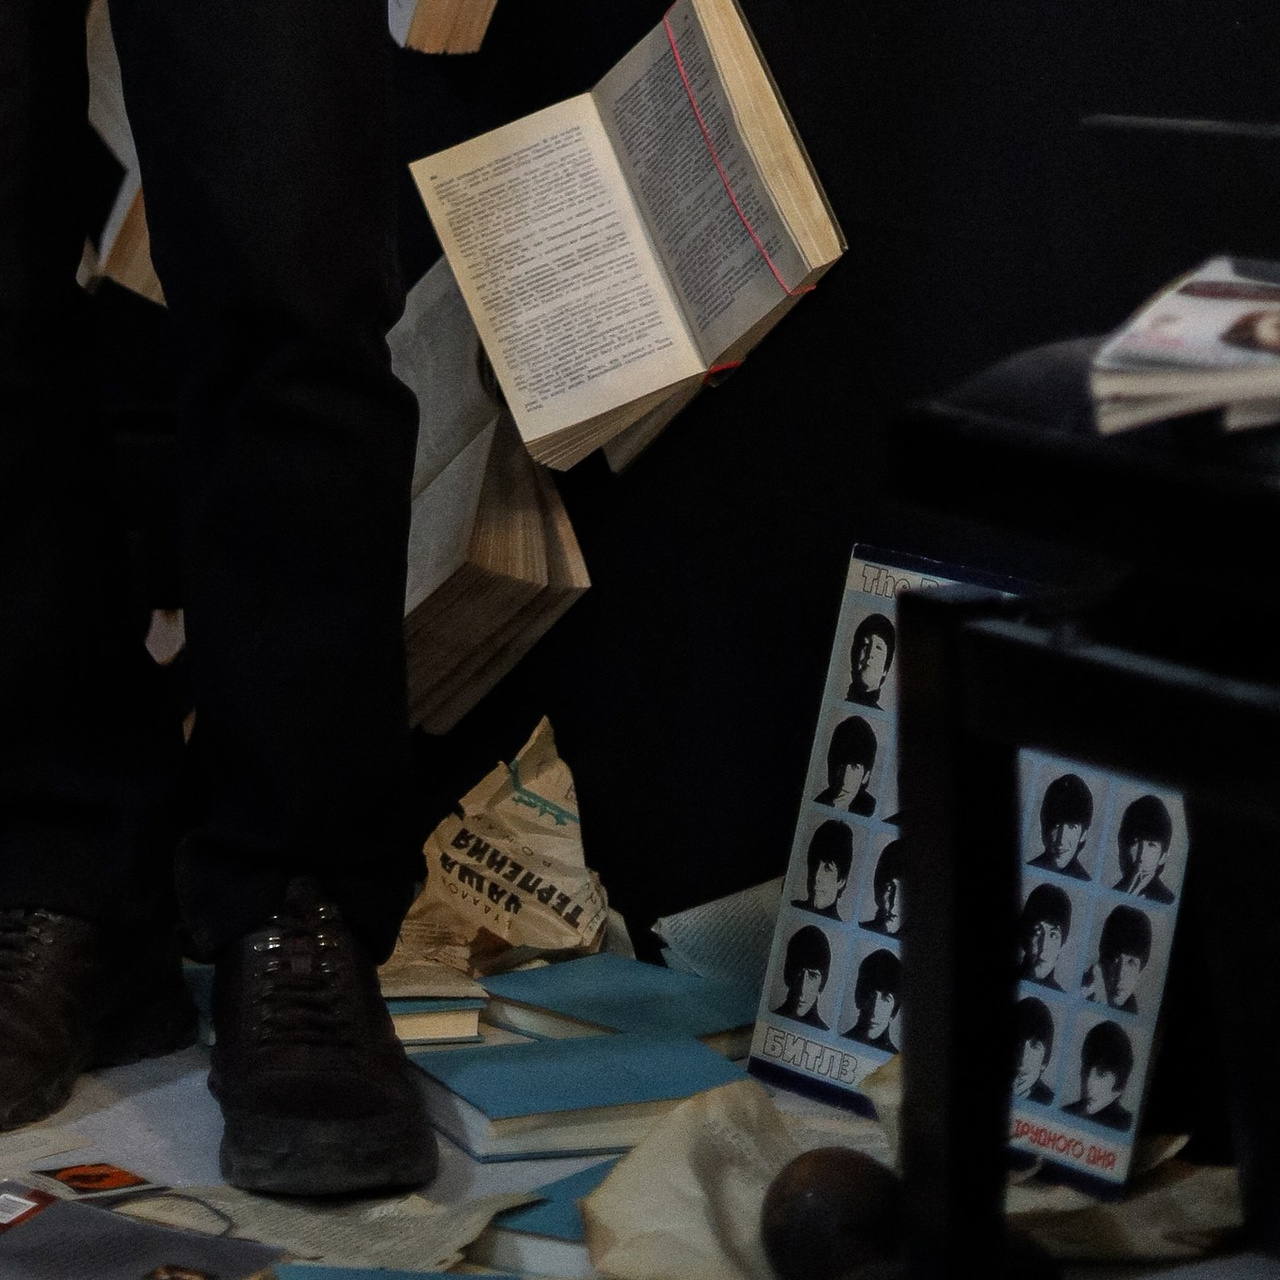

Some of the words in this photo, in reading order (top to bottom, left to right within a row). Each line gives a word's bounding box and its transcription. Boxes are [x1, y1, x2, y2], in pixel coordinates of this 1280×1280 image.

[440, 851, 522, 914] ЧАША
[451, 827, 584, 930] ТЕРПЕНИЯ
[763, 1026, 858, 1085] БИТЛЗ
